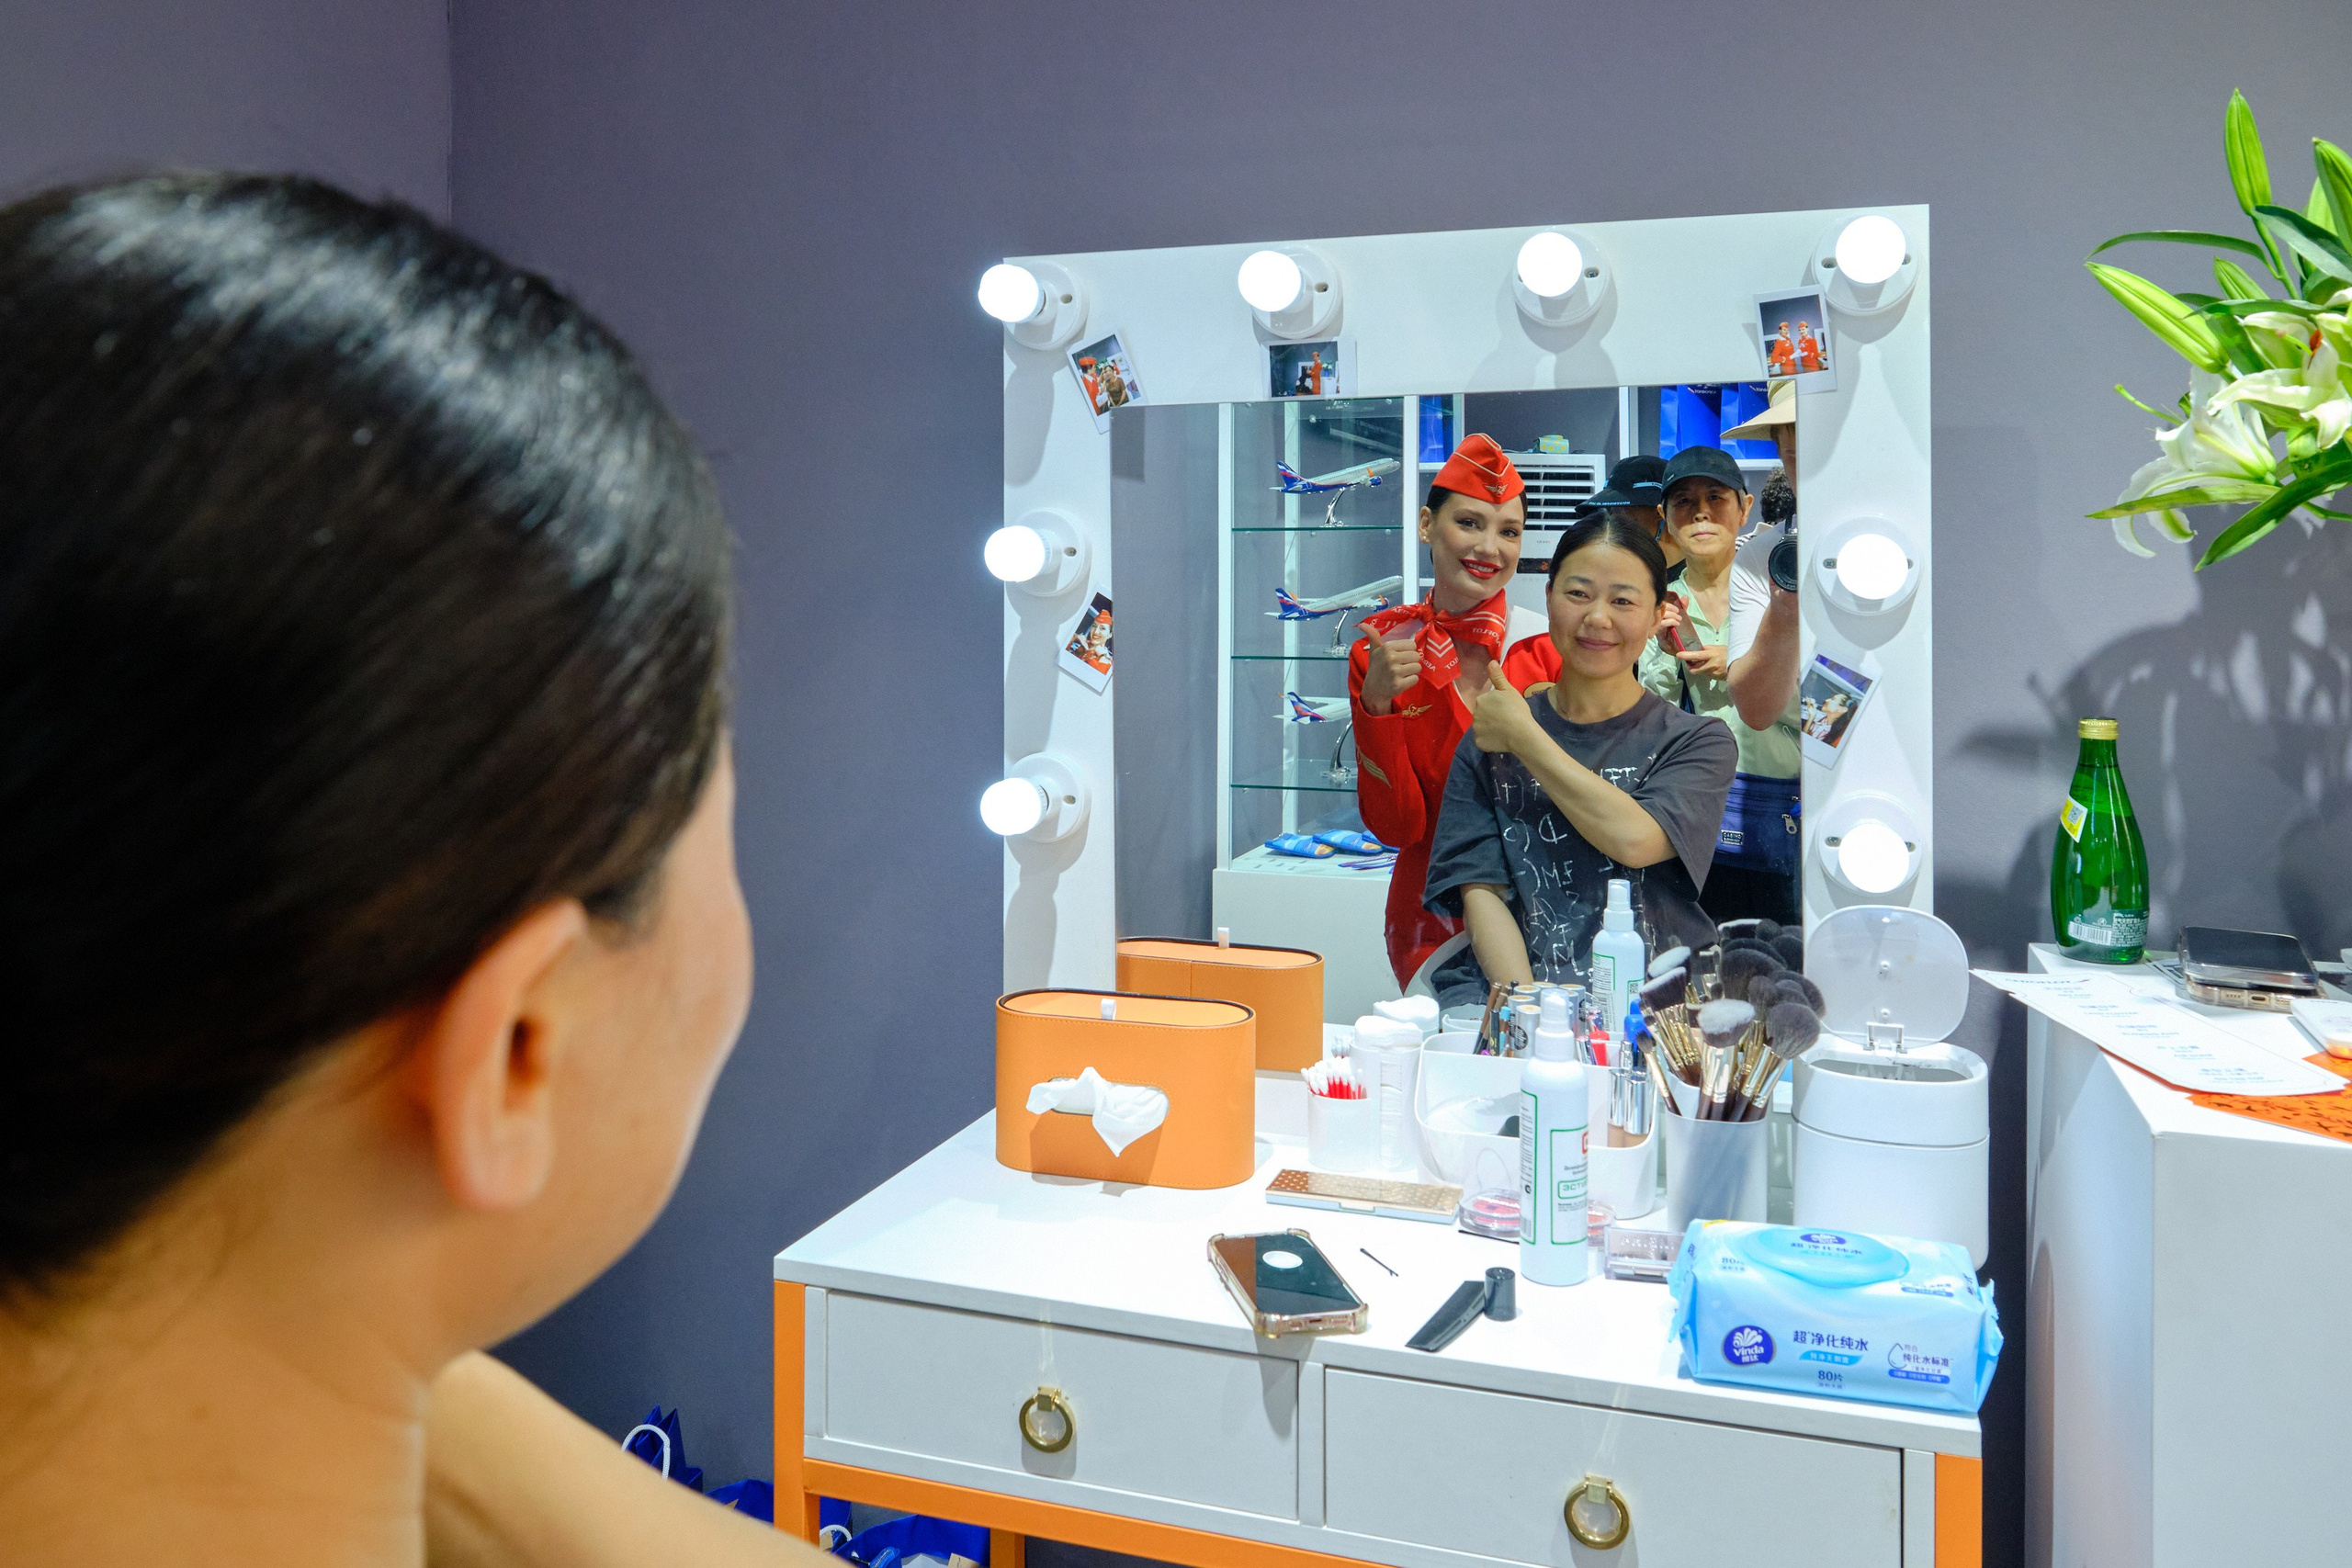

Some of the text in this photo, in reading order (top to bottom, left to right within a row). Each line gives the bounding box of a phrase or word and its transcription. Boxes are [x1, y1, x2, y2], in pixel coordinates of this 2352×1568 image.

[1792, 1329, 1869, 1351] 超净化纯水
[1817, 1370, 1844, 1382] 80片
